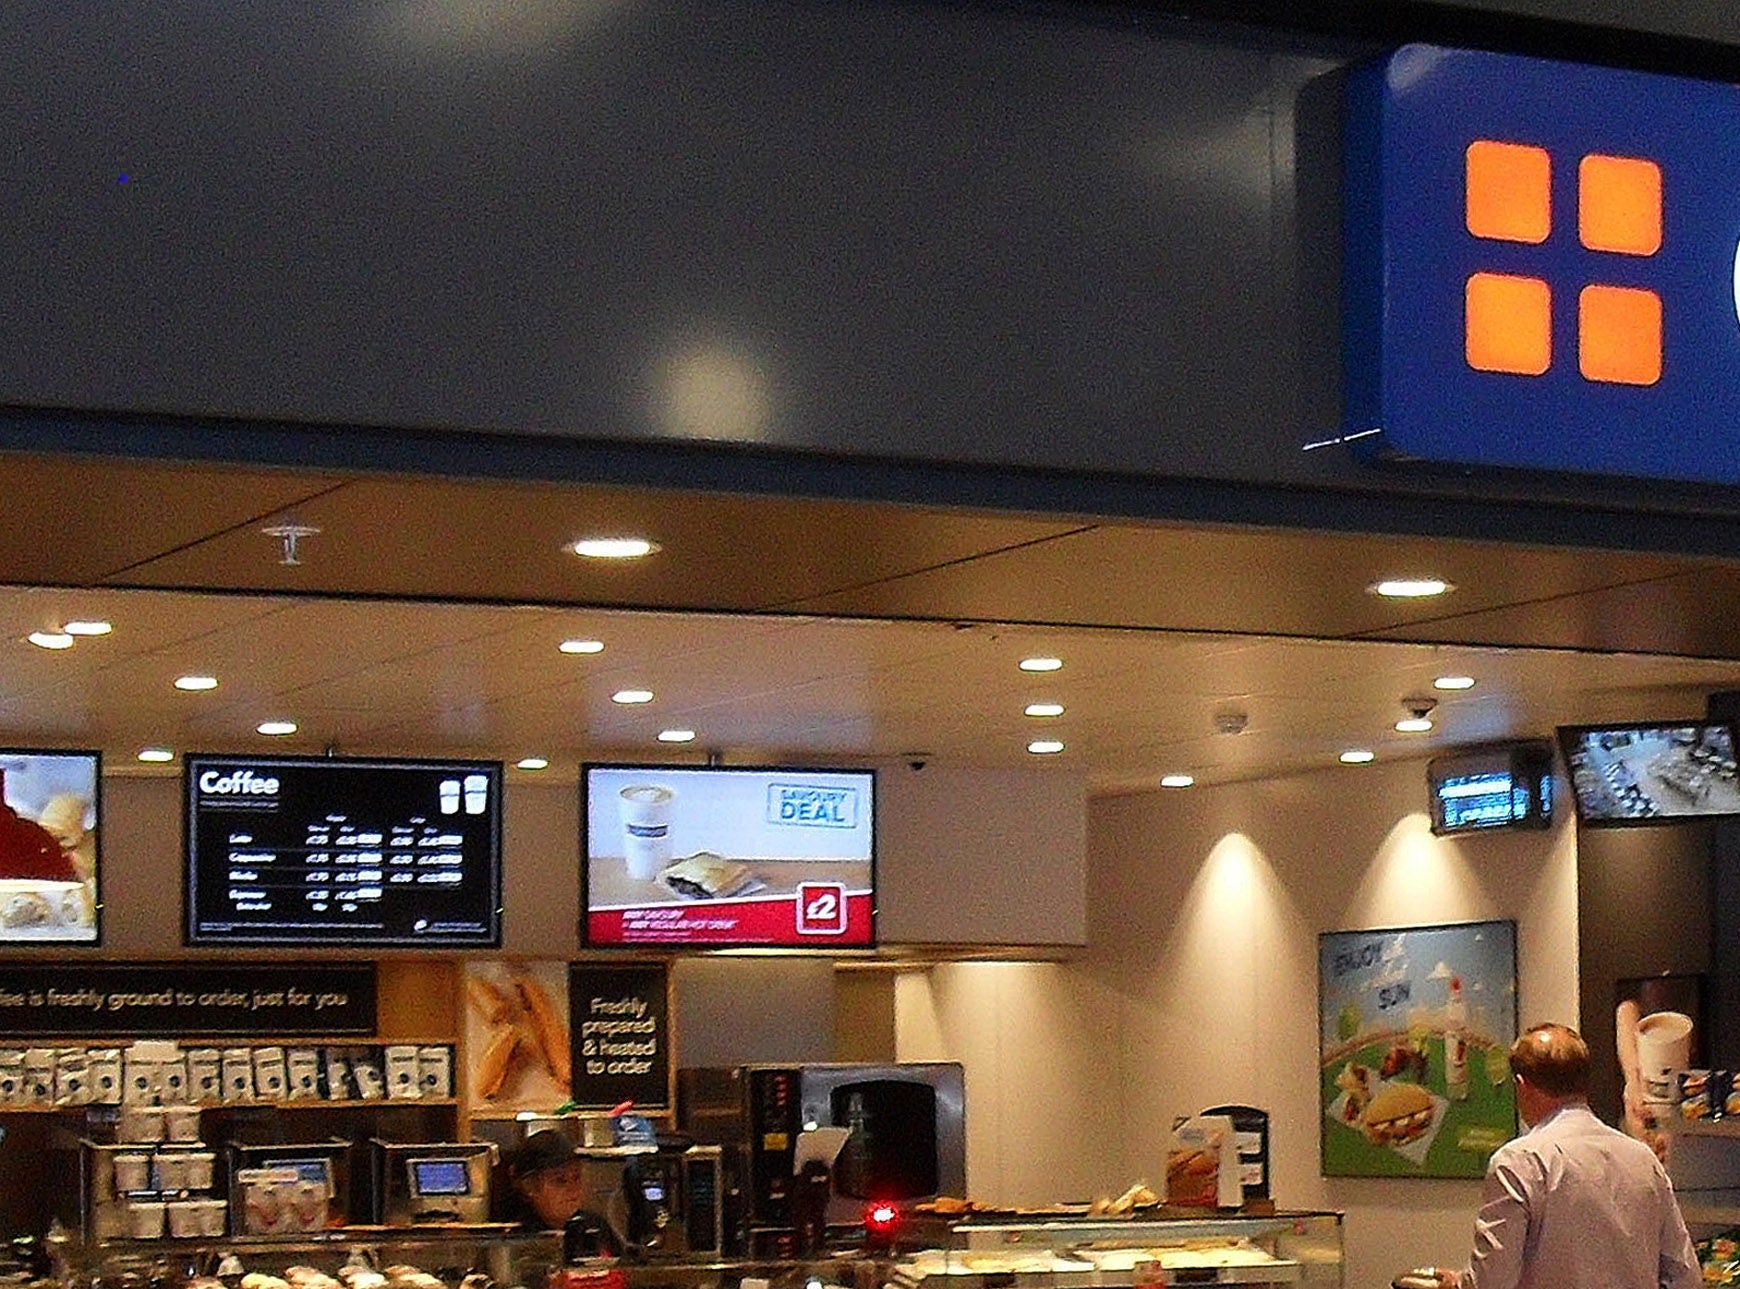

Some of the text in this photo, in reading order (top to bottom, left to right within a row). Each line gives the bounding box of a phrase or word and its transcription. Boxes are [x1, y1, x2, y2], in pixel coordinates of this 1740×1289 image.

[200, 771, 280, 796] Coffee
[781, 801, 846, 822] DEAL
[806, 894, 836, 919] £2
[47, 987, 106, 1012] freshly
[107, 988, 174, 1011] ground
[177, 990, 196, 1007] to
[251, 989, 285, 1011] just
[287, 986, 312, 1006] for
[314, 993, 348, 1011] you
[590, 996, 648, 1019] Freshly
[582, 1016, 657, 1039] prepared
[582, 1038, 657, 1056] & heated
[586, 1056, 653, 1075] to order
